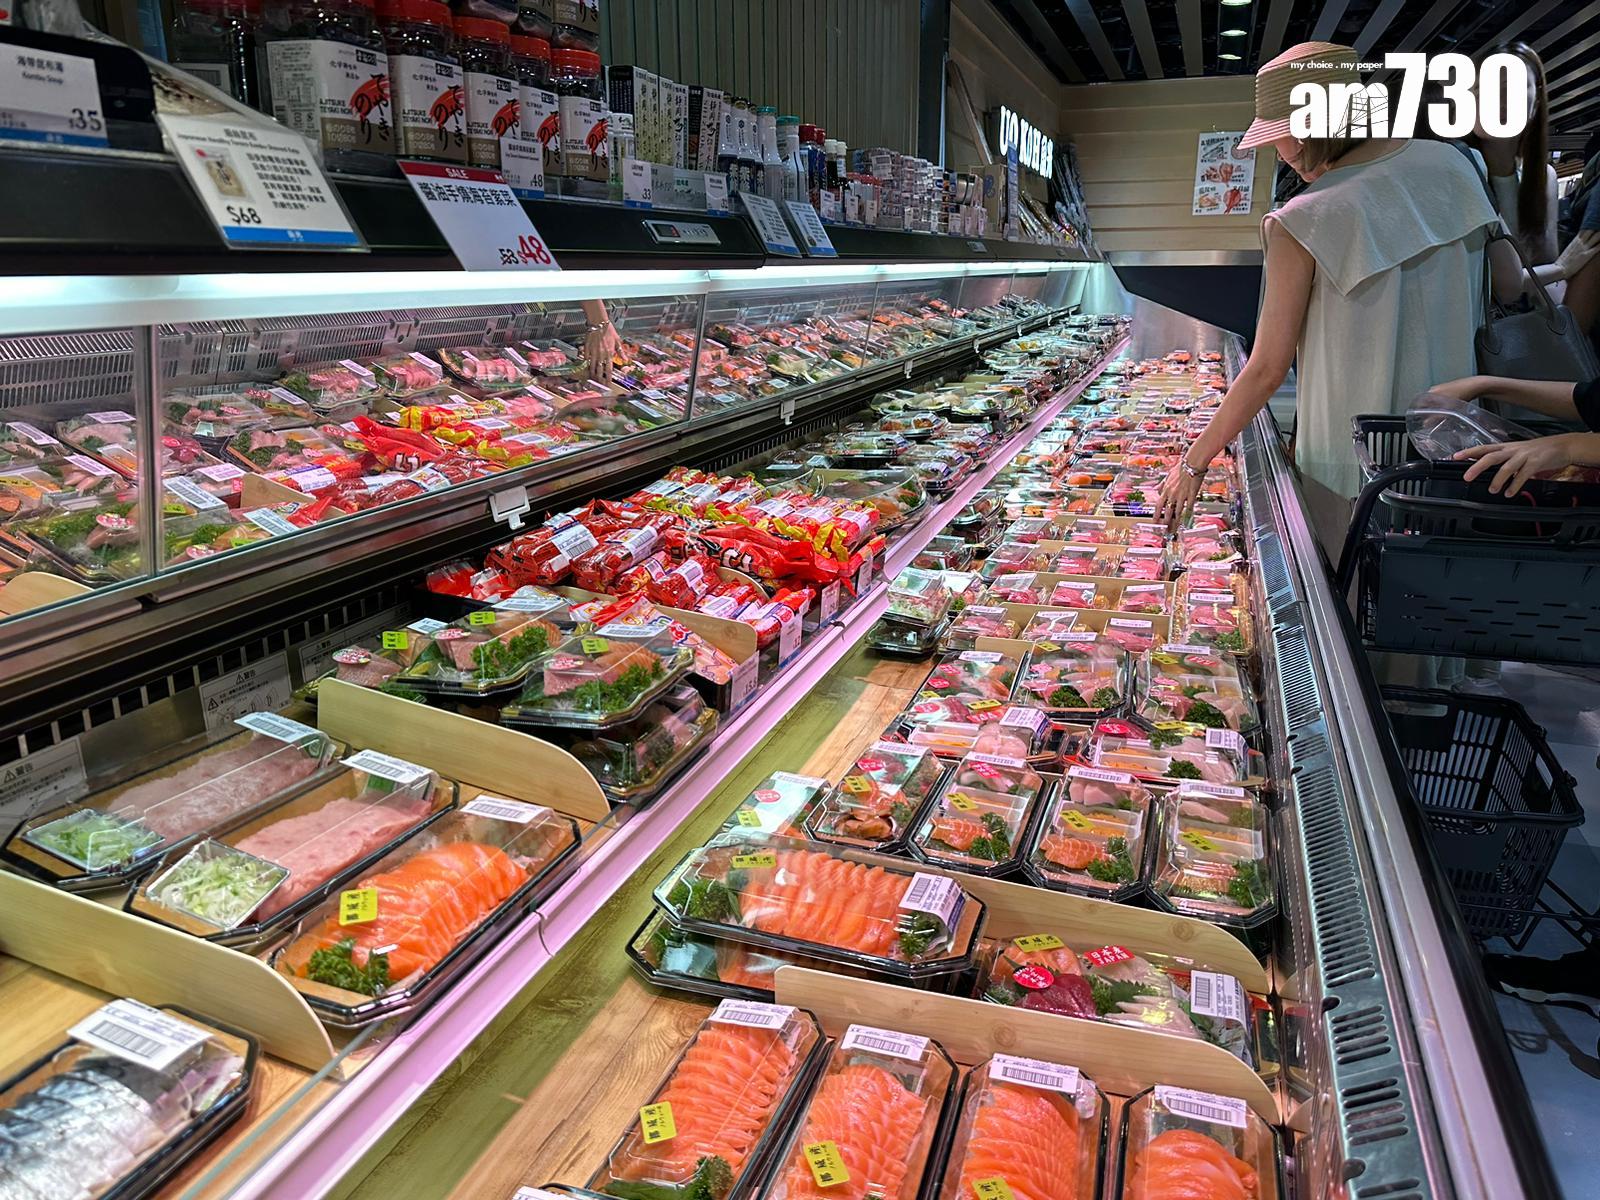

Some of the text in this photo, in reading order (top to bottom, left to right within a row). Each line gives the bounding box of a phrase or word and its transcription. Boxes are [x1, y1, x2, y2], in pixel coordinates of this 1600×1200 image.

[445, 167, 469, 180] SALE
[226, 205, 262, 225] $68
[517, 234, 551, 266] $48
[1097, 951, 1130, 965] JAPAN
